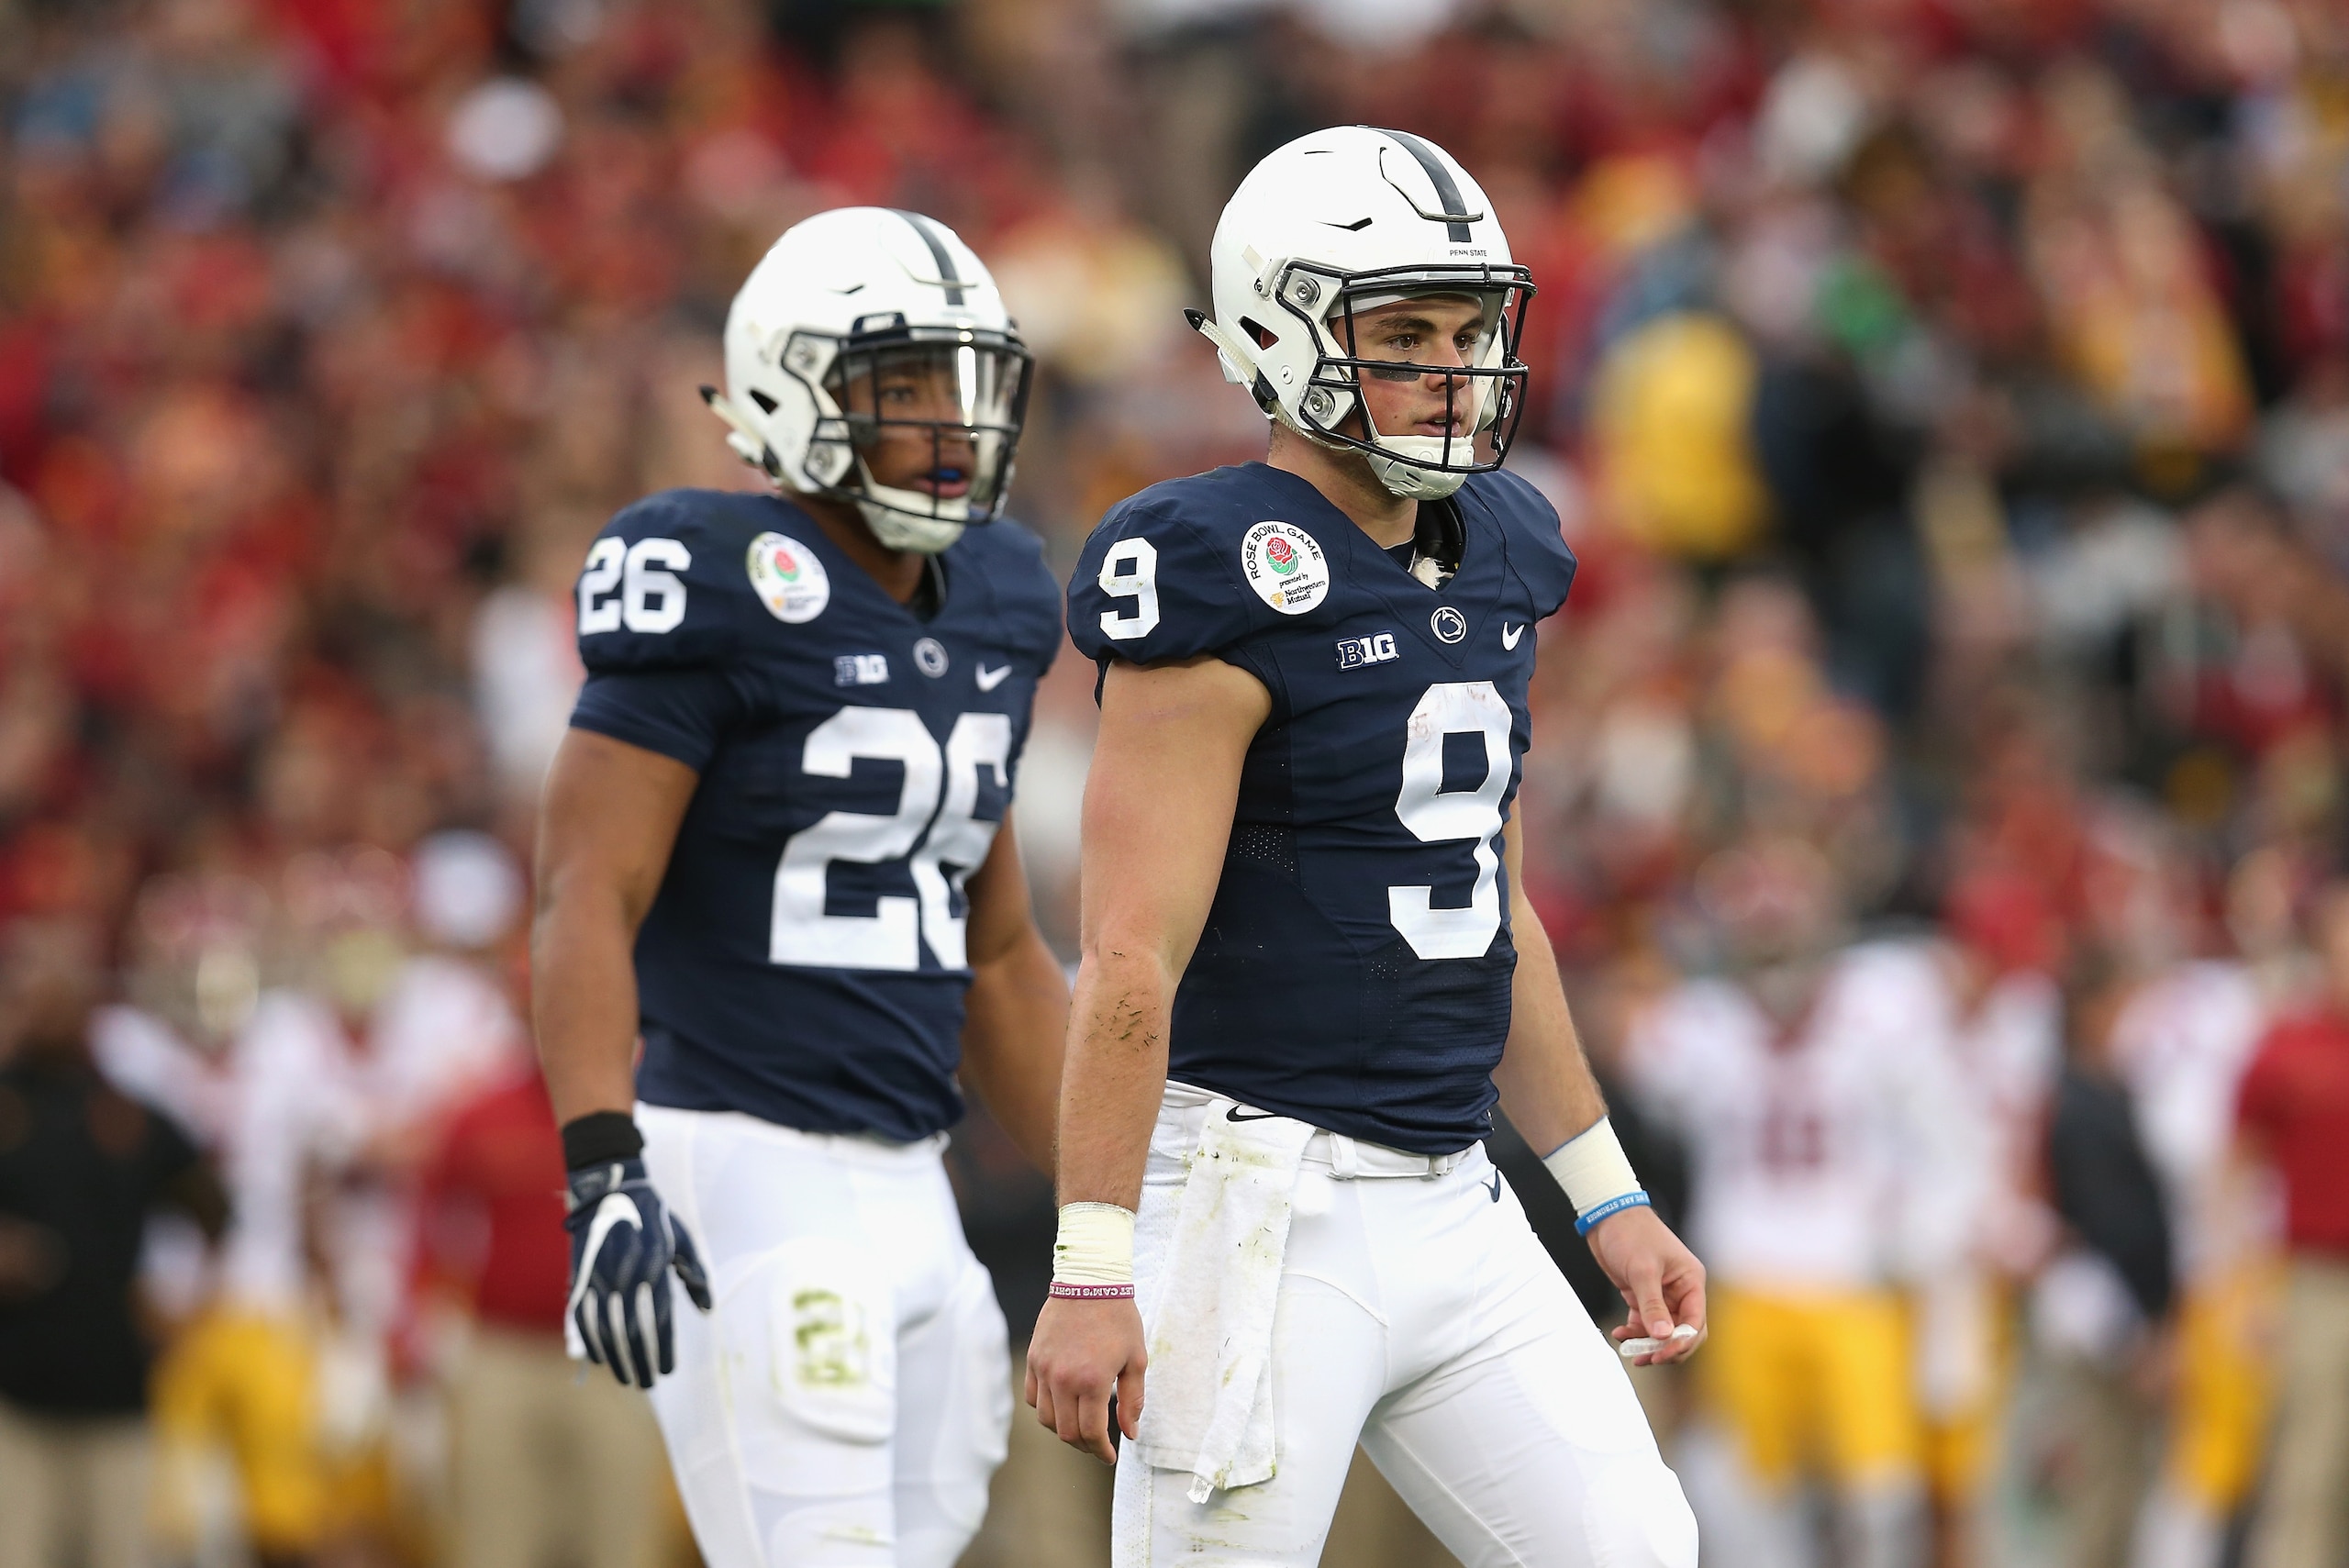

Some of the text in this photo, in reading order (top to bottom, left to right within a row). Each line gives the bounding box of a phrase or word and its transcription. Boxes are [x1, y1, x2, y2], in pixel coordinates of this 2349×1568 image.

[1469, 249, 1487, 257] STATE
[1246, 525, 1321, 580] ROSE BOWL GAME
[578, 536, 692, 636] 26
[1097, 537, 1160, 641] 9
[1279, 573, 1308, 589] presented by
[1285, 580, 1326, 597] Northwestern
[1286, 590, 1311, 606] Mutual
[1387, 681, 1513, 961] 9
[769, 705, 1011, 973] 26
[1619, 1195, 1634, 1206] ARE
[1586, 1200, 1619, 1223] STRONGER
[1055, 1286, 1081, 1296] LIGHT
[1083, 1287, 1119, 1296] CAM'S
[1119, 1286, 1133, 1296] LET
